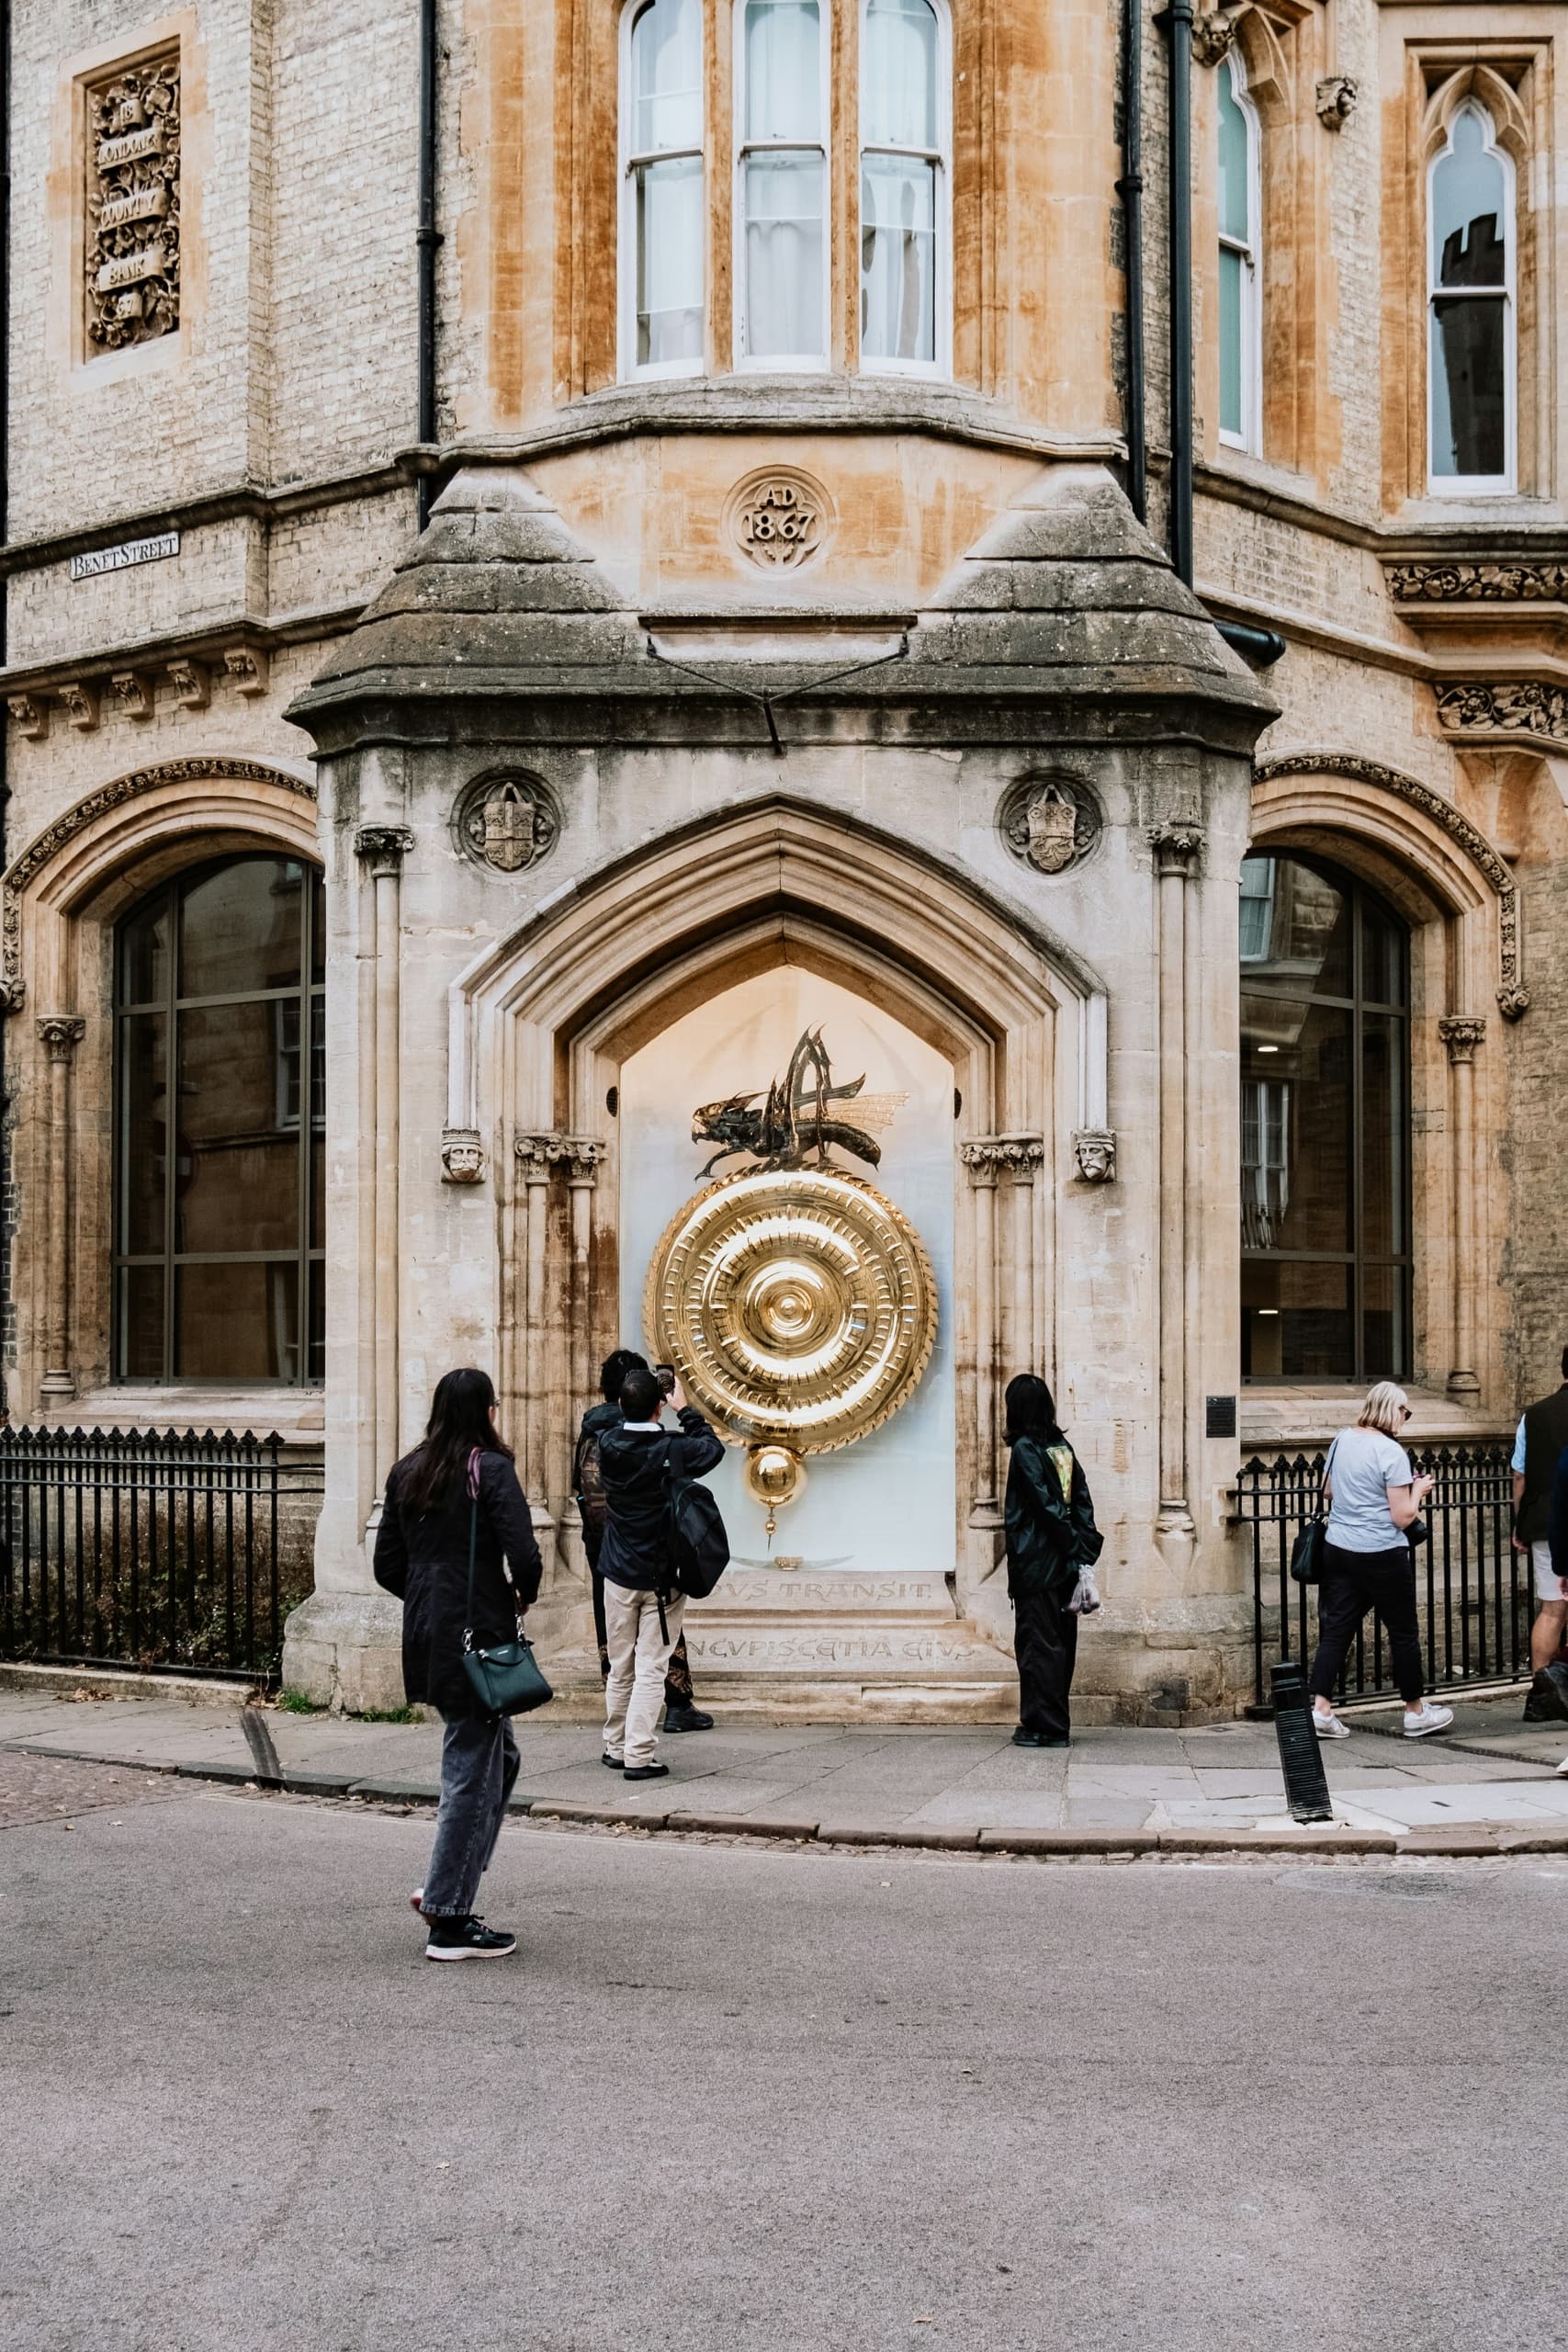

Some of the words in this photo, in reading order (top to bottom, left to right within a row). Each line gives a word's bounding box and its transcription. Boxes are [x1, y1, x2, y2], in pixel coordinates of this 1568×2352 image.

[98, 138, 147, 165] LONDON
[101, 194, 156, 228] COUNTY
[109, 259, 145, 285] BANK
[741, 513, 817, 543] 1867
[120, 537, 176, 564] STREET
